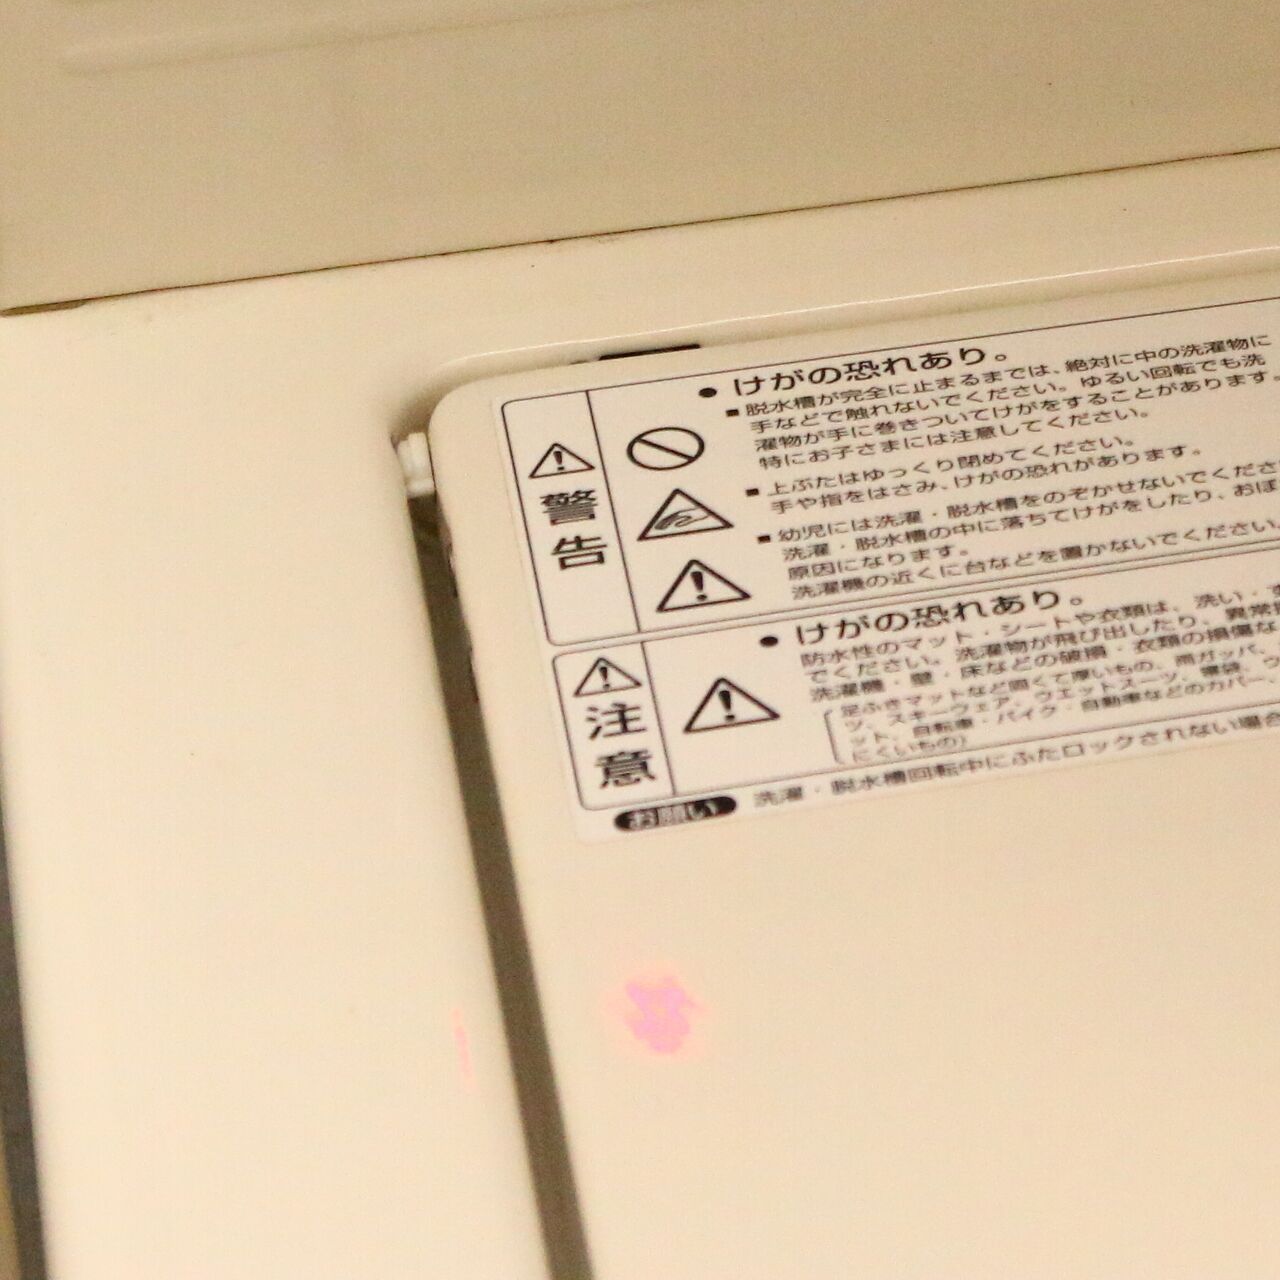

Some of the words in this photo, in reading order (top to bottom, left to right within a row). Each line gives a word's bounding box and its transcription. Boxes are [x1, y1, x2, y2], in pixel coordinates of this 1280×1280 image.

[732, 346, 1008, 398] けがの恐れあり。
[794, 589, 1084, 647] けがの恐れあり。
[584, 700, 659, 790] 注意
